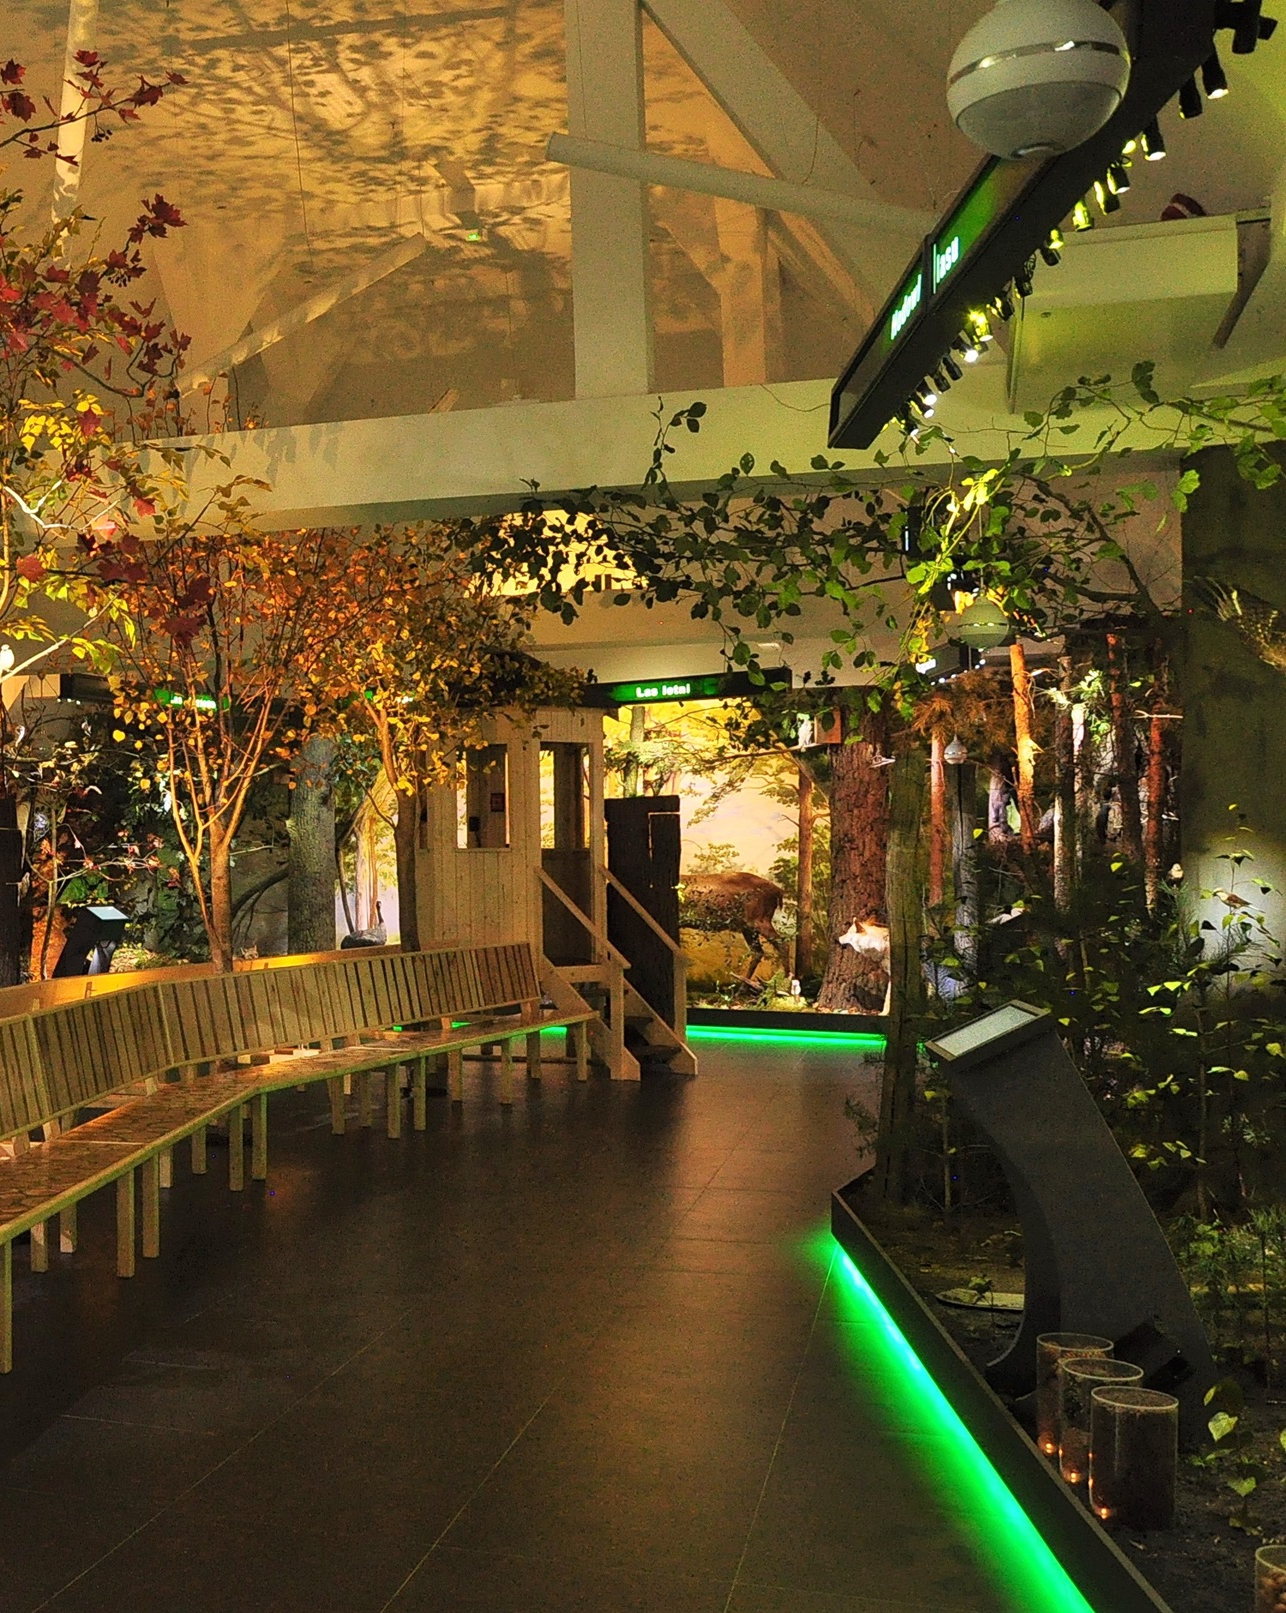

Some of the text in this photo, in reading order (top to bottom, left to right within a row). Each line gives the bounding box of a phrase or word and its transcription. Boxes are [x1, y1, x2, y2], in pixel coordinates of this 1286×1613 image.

[890, 236, 959, 340] Hodowl lasu
[636, 687, 658, 698] Las
